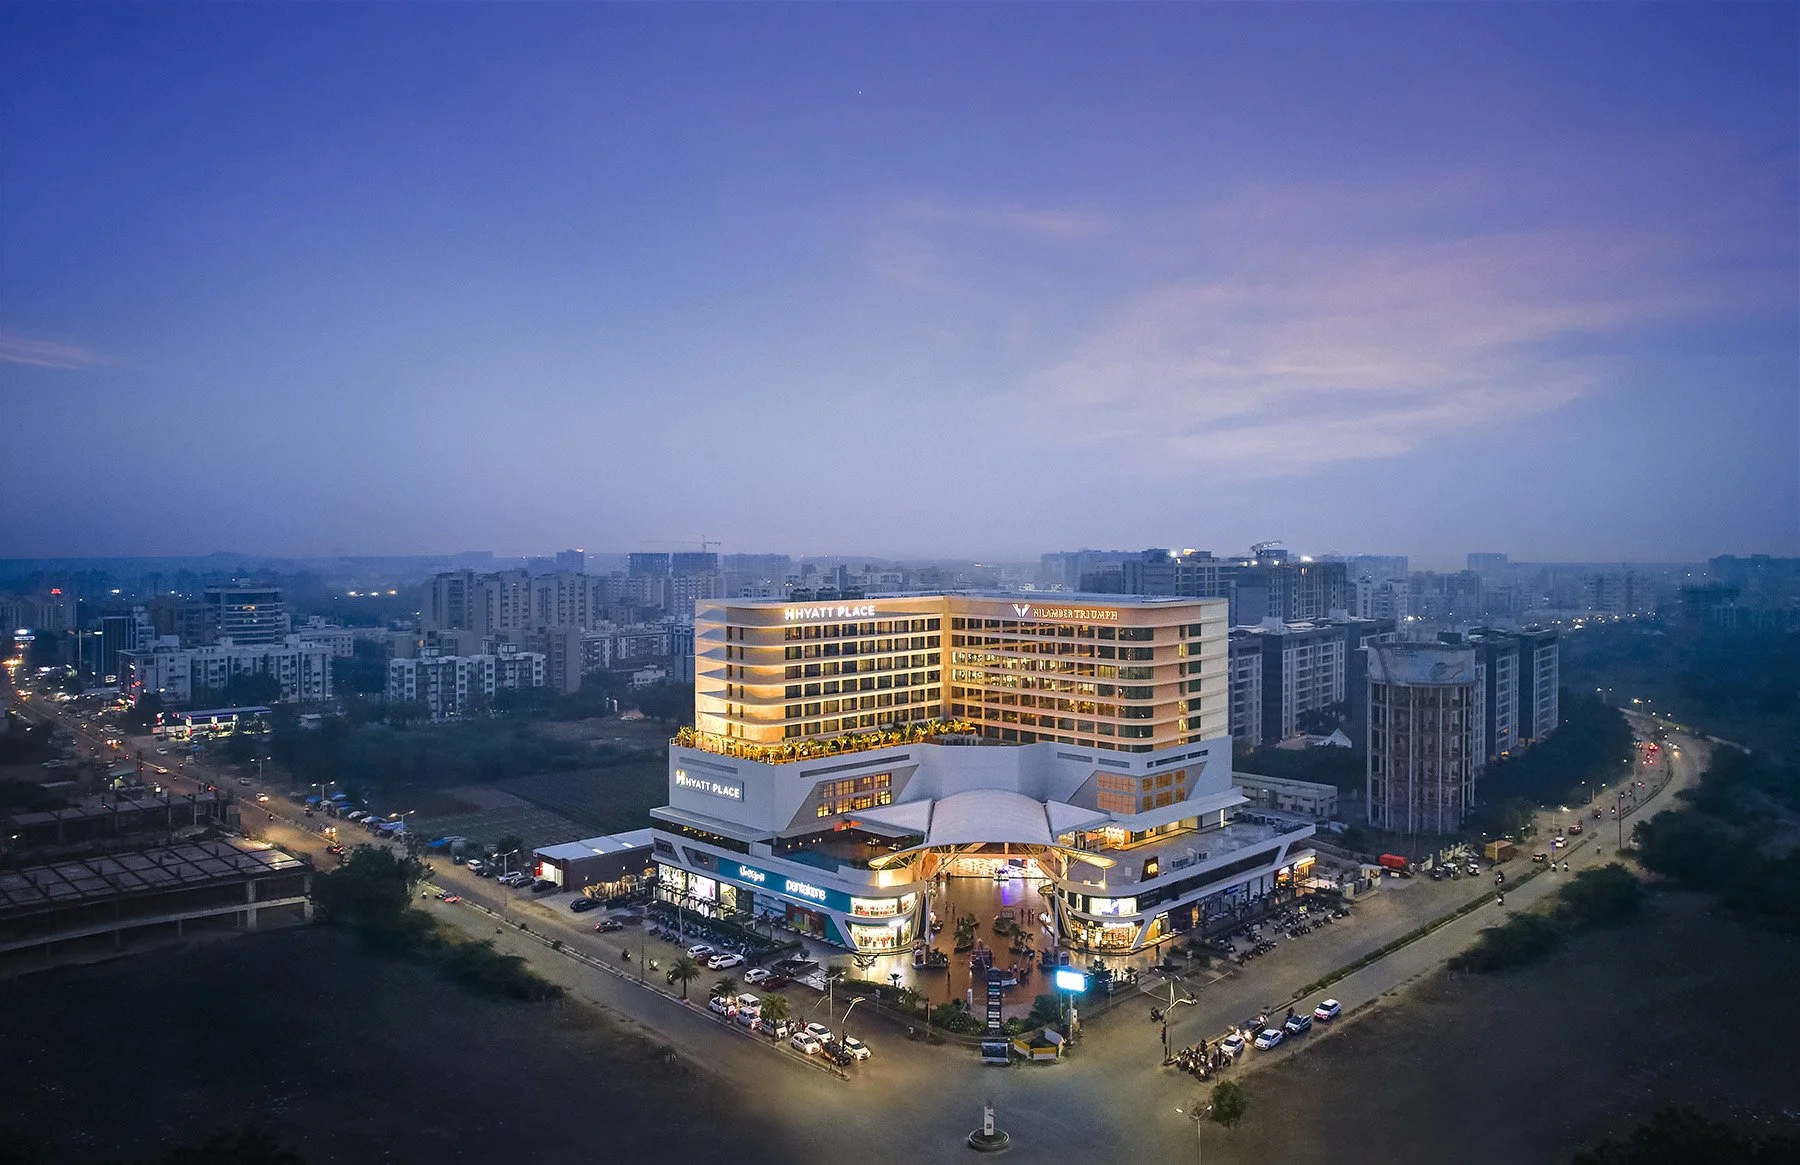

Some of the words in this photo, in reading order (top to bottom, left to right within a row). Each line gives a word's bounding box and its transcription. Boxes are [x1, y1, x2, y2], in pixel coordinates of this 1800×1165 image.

[795, 607, 834, 619] HYATT
[837, 605, 875, 617] PLACE
[685, 777, 711, 791] HYATT
[712, 783, 740, 798] PLACE
